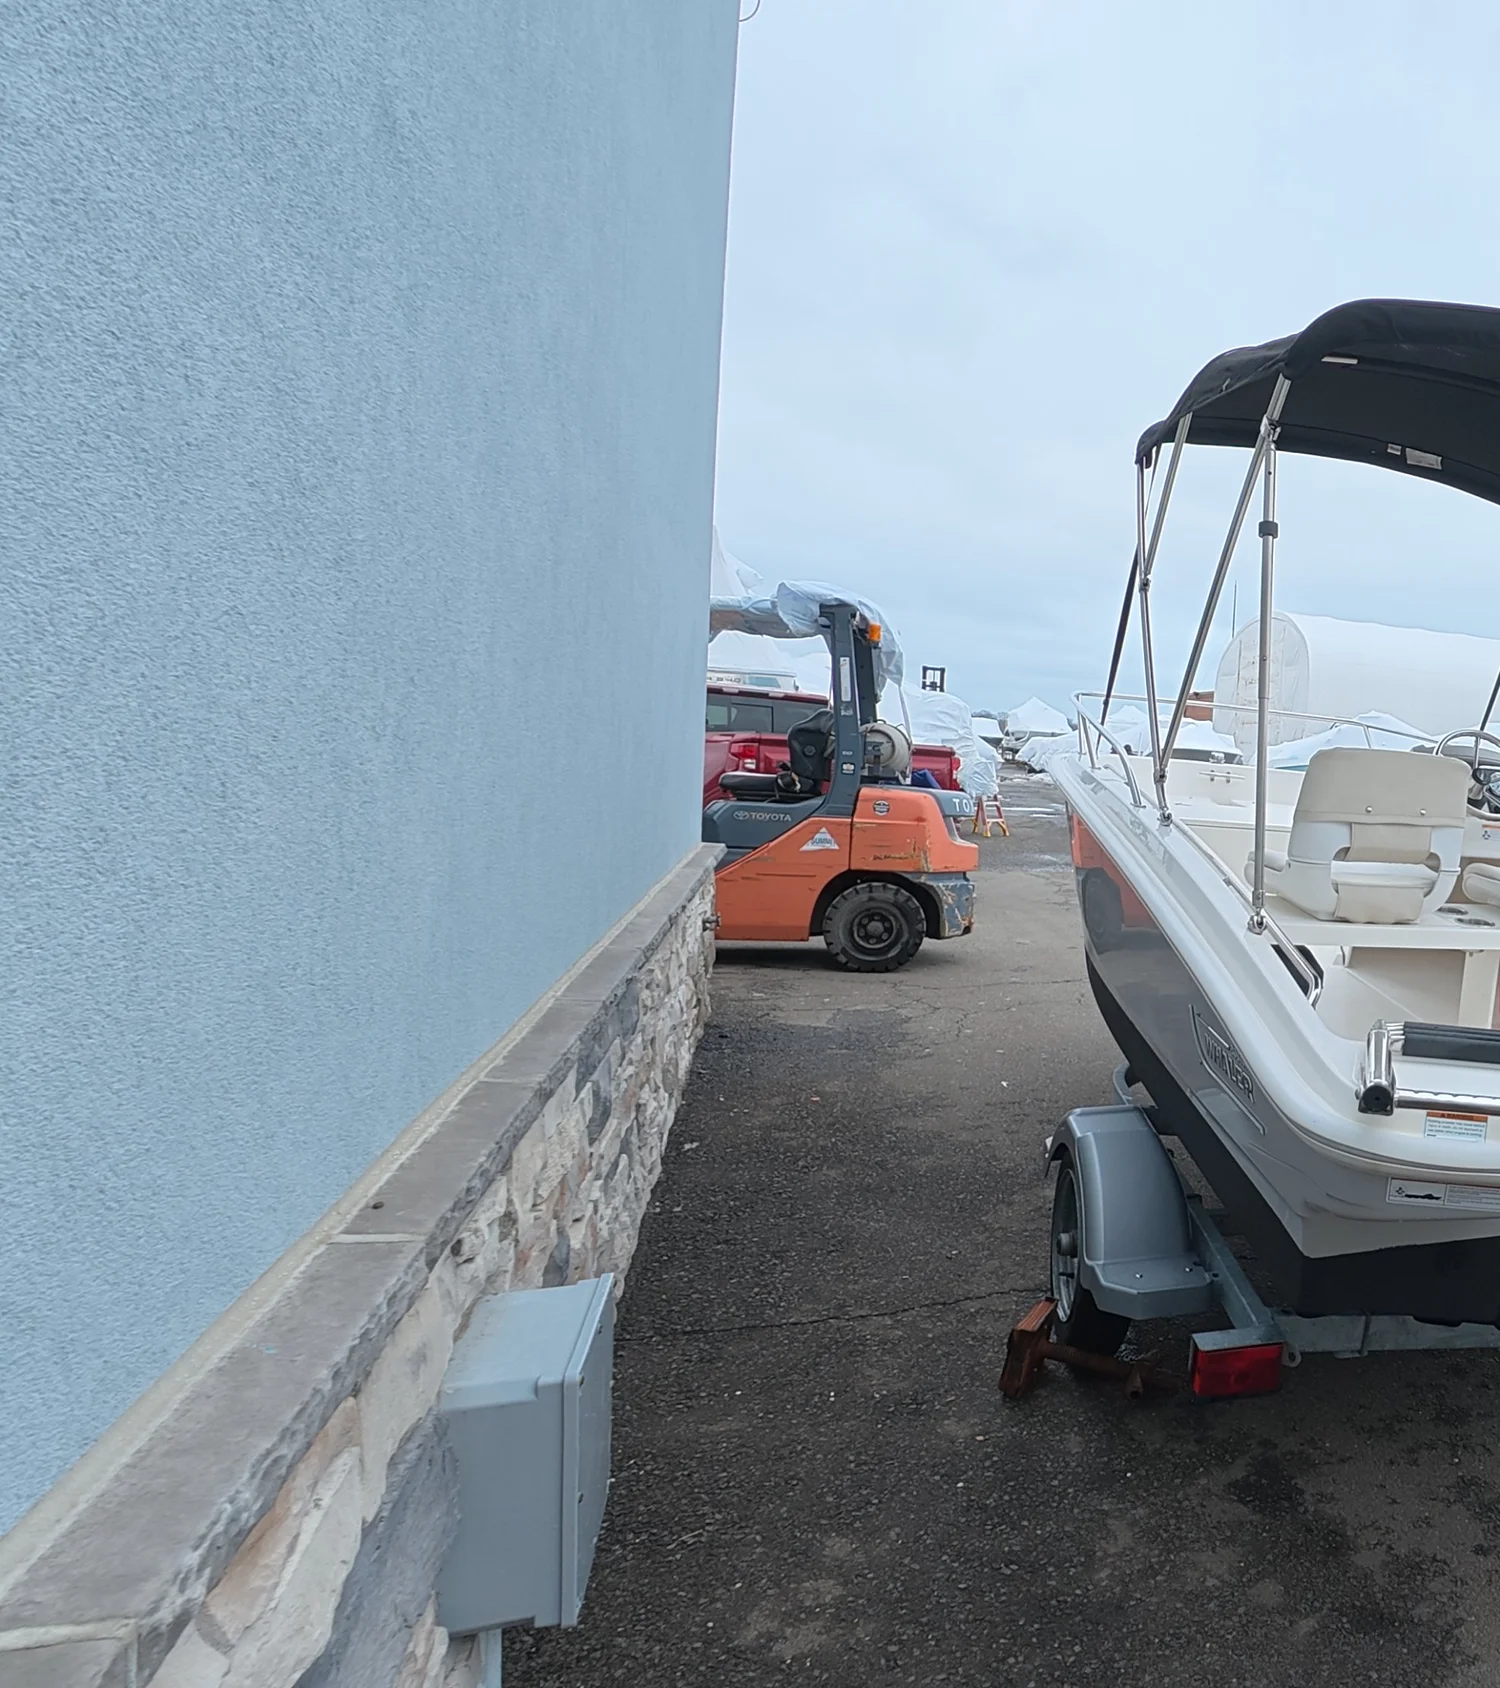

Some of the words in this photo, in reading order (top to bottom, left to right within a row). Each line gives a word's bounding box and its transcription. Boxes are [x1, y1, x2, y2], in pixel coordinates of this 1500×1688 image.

[952, 798, 974, 812] TO
[750, 811, 792, 821] TOYOTA
[1204, 1033, 1255, 1104] WHALER
